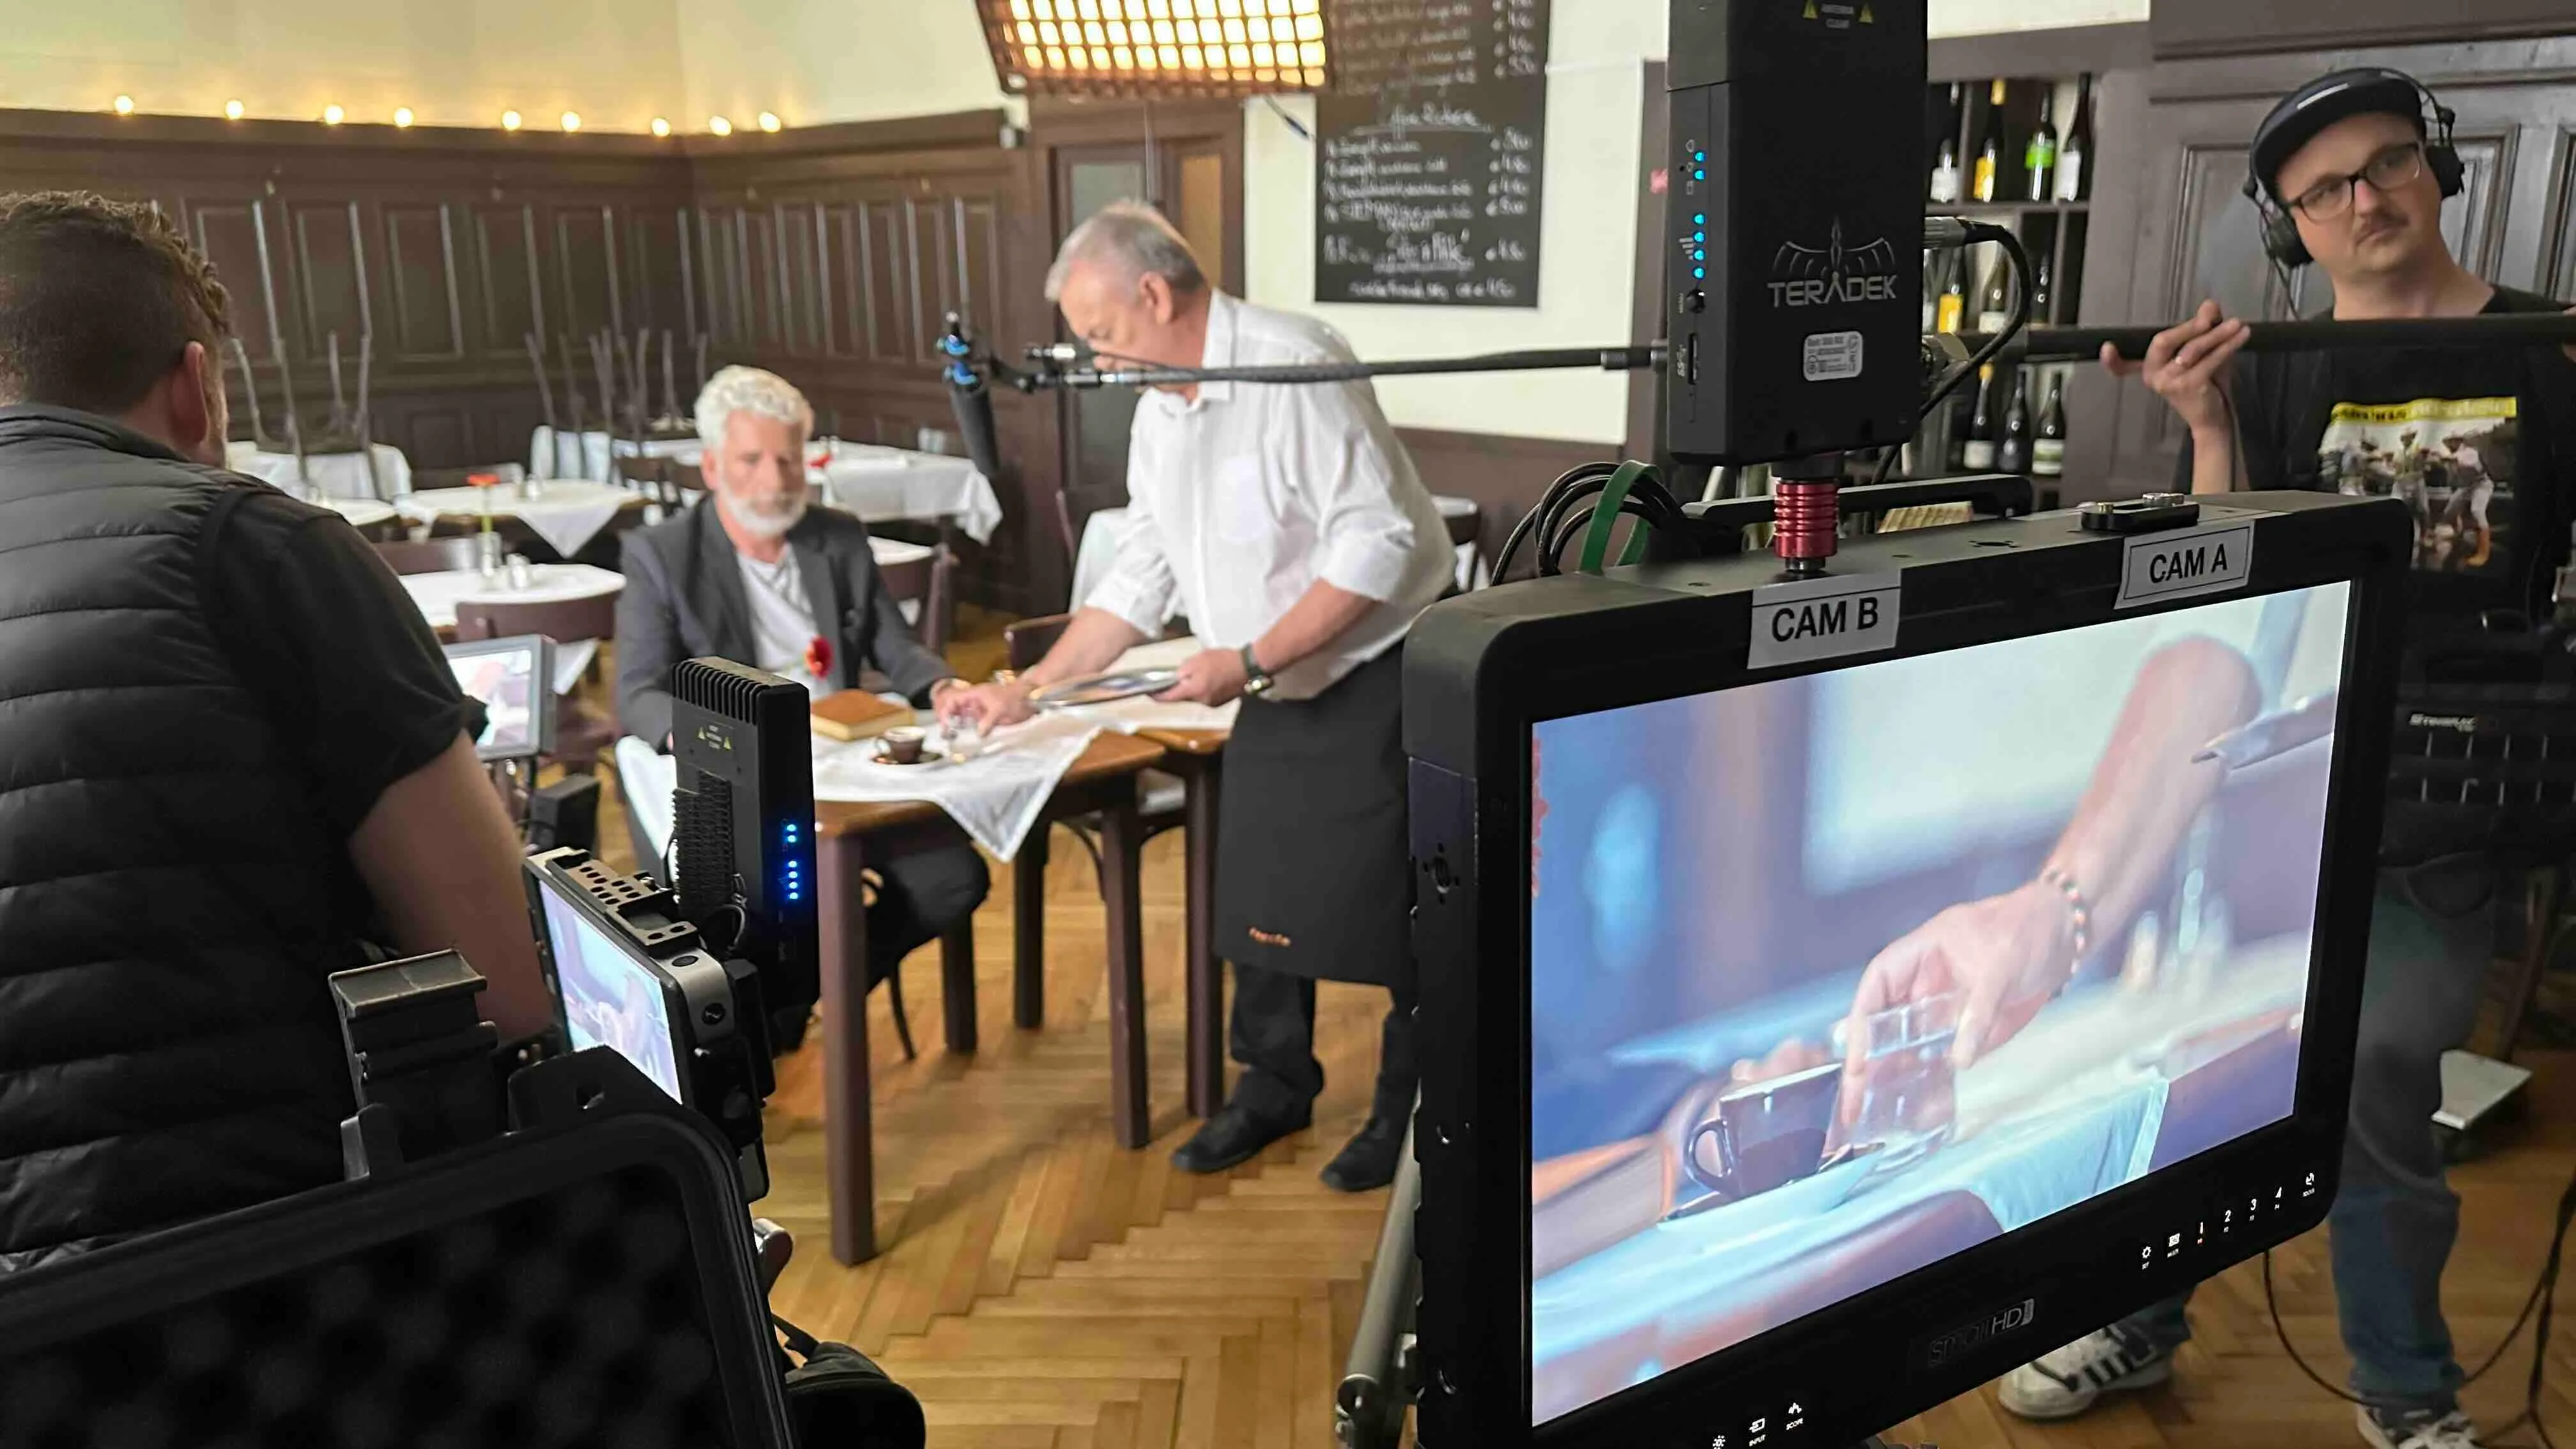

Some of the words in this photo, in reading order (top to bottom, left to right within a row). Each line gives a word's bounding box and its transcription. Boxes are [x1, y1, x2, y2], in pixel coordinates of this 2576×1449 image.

[1767, 272, 1897, 308] TERADEK
[2149, 546, 2206, 584] CAM
[2211, 543, 2228, 574] A
[1772, 600, 1848, 643] CAM
[1857, 597, 1878, 631] B
[2199, 1222, 2204, 1234] 1
[2225, 1209, 2232, 1223] 2
[2250, 1198, 2257, 1211] 3
[2274, 1186, 2282, 1199] 4
